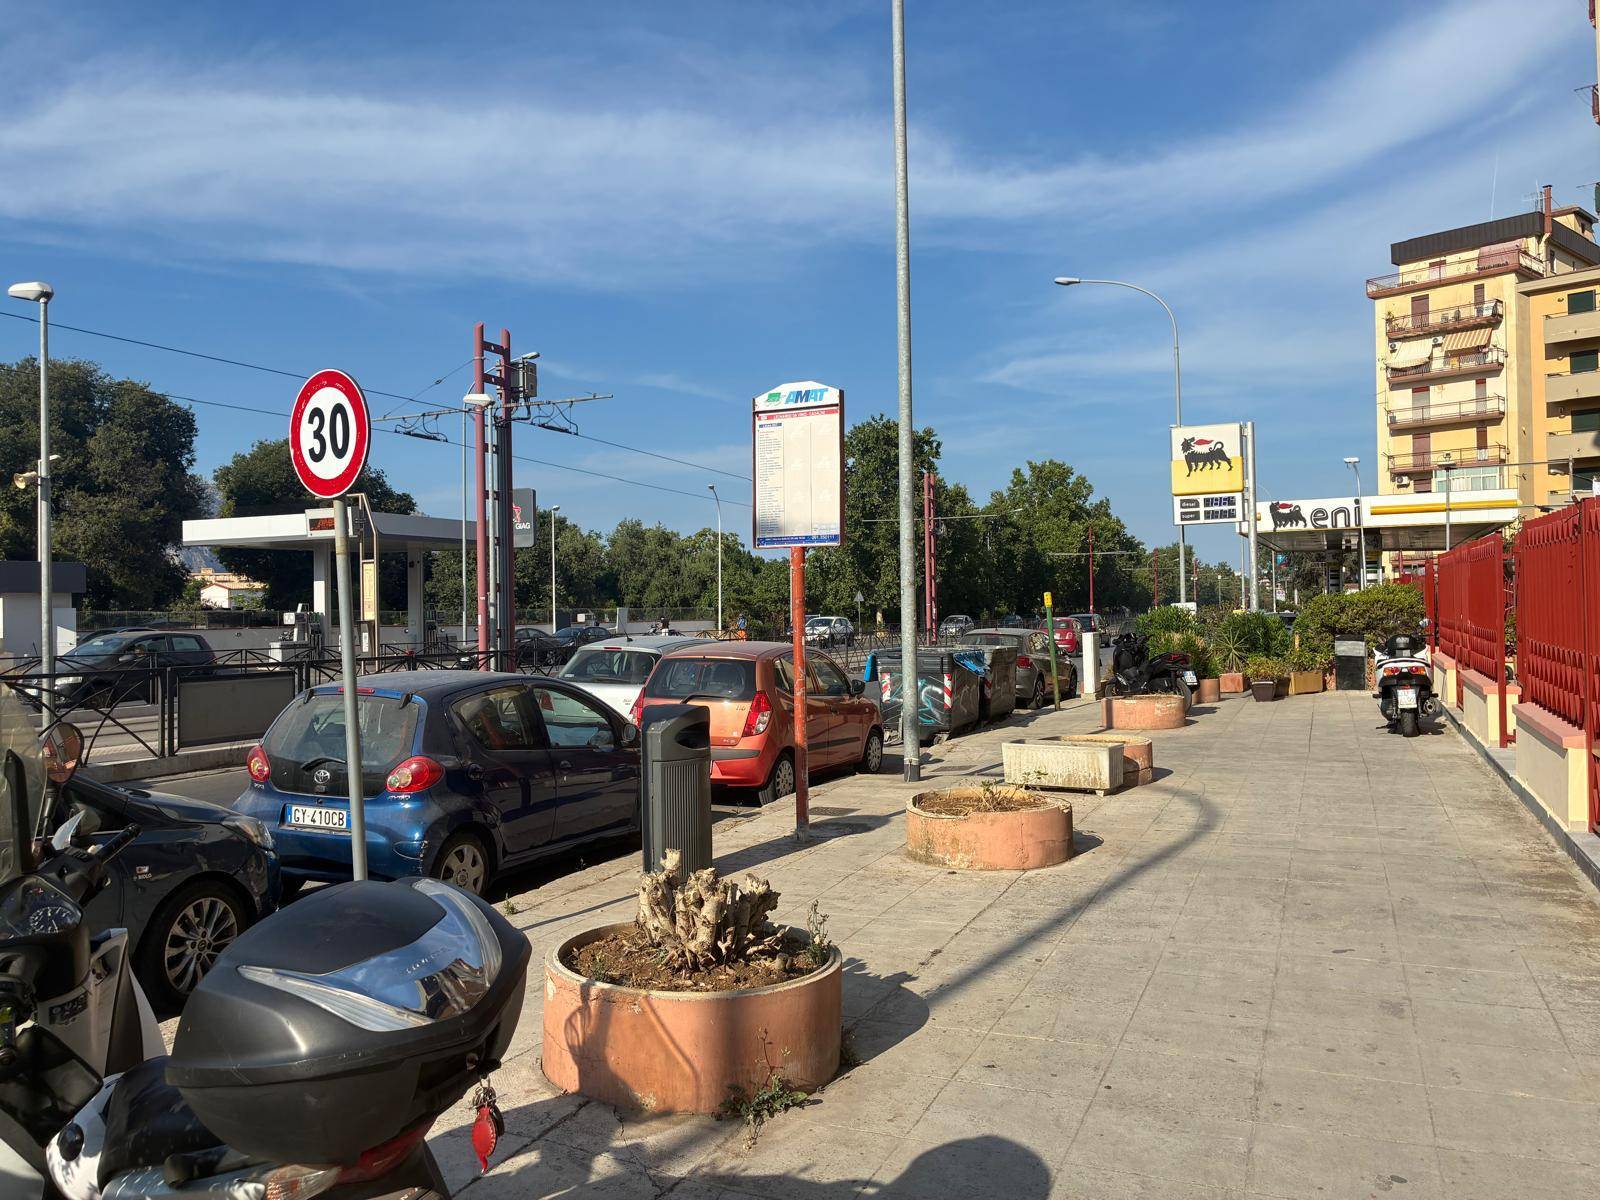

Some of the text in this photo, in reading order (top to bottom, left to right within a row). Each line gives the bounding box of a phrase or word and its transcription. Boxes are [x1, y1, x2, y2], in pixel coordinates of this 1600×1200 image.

[784, 387, 828, 404] AMAT
[307, 402, 350, 463] 30
[1310, 498, 1361, 529] eni
[293, 808, 345, 827] GY 410CB
